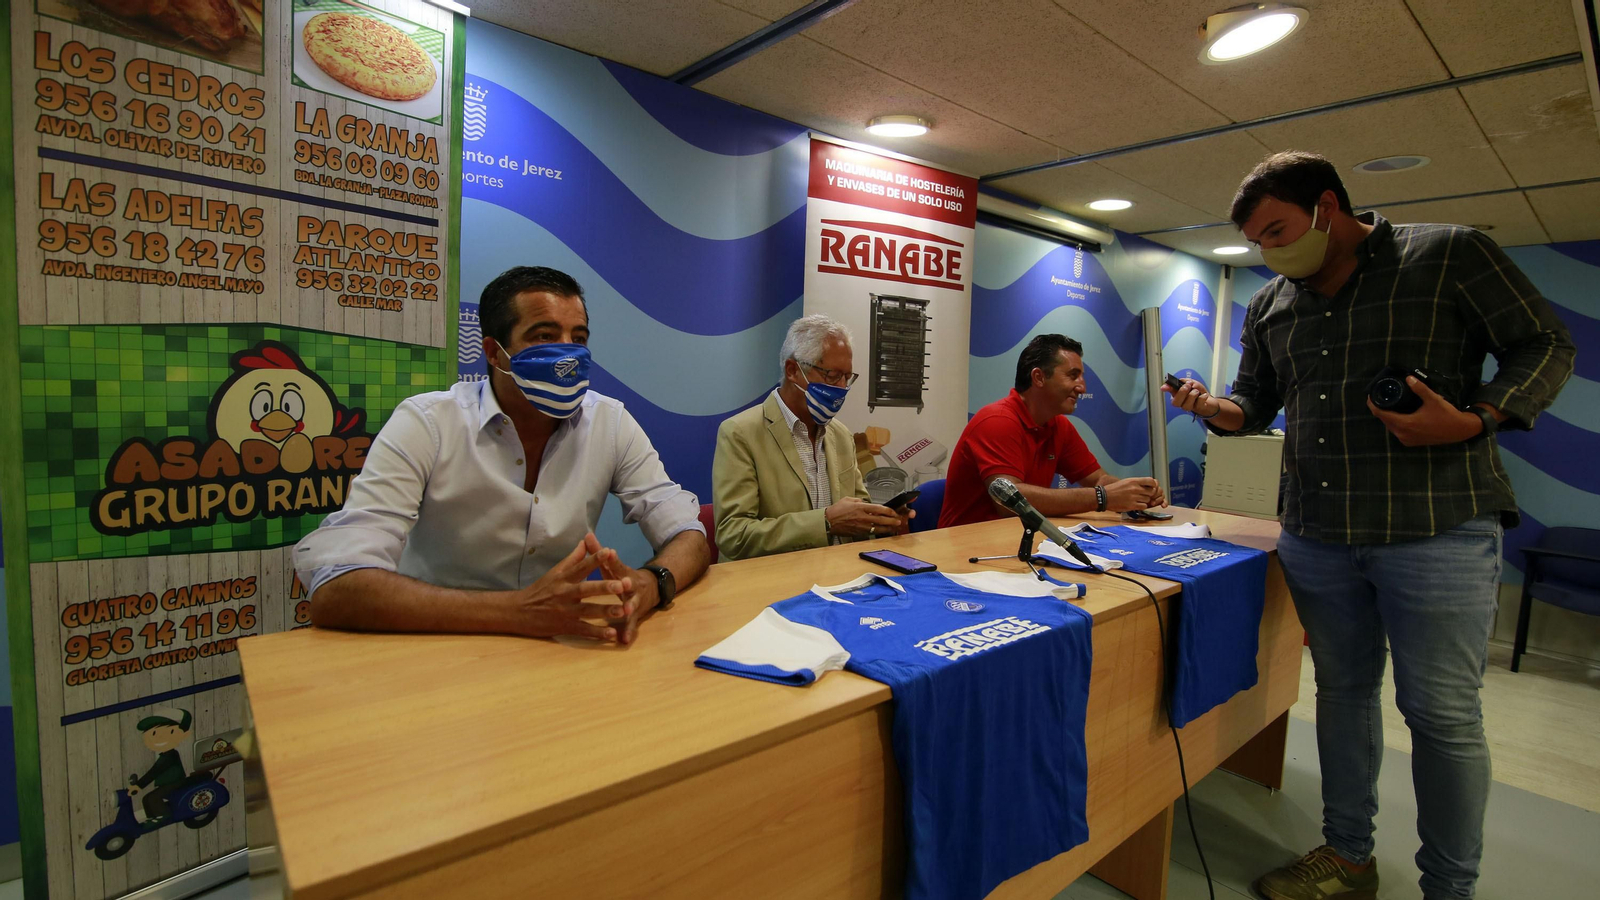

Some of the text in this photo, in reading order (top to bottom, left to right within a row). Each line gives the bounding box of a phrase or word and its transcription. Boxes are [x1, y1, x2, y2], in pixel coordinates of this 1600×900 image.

[34, 30, 266, 120] LOS CEDROS
[35, 78, 266, 154] 956 16 90 41
[295, 101, 331, 139] LA
[35, 114, 102, 144] AVDA.
[175, 141, 200, 162] DE
[294, 139, 439, 191] 956 08 09 60
[462, 172, 504, 188] ortes
[499, 155, 518, 171] de
[522, 160, 562, 180] Jerez
[825, 159, 965, 199] MAQUINARIA DE HOSTELERÍA
[39, 172, 264, 237] LAS ADELFAS
[295, 169, 318, 185] BDA.
[319, 174, 332, 187] LA
[379, 187, 408, 202] PLAZA
[409, 193, 439, 208] RONDA
[827, 175, 962, 213] Y ENVASES DE UN SOLO USO
[38, 219, 266, 274] 956 18 42 76
[297, 216, 438, 260] PARQUE
[820, 228, 962, 281] RANABE
[42, 259, 93, 279] AVDA.
[178, 273, 223, 291] ANGEL
[224, 277, 264, 294] MAYO
[296, 268, 438, 301] 956 32 02 22
[338, 294, 402, 312] CALLE MAR
[113, 433, 372, 483] ASADORE
[897, 438, 931, 462] RANABE
[99, 474, 358, 529] GRUPO RAN
[61, 593, 157, 628] CUATRO
[64, 604, 256, 665] 956 14 11 96
[920, 617, 1040, 657] RANABE
[143, 646, 197, 670] CUATRO
